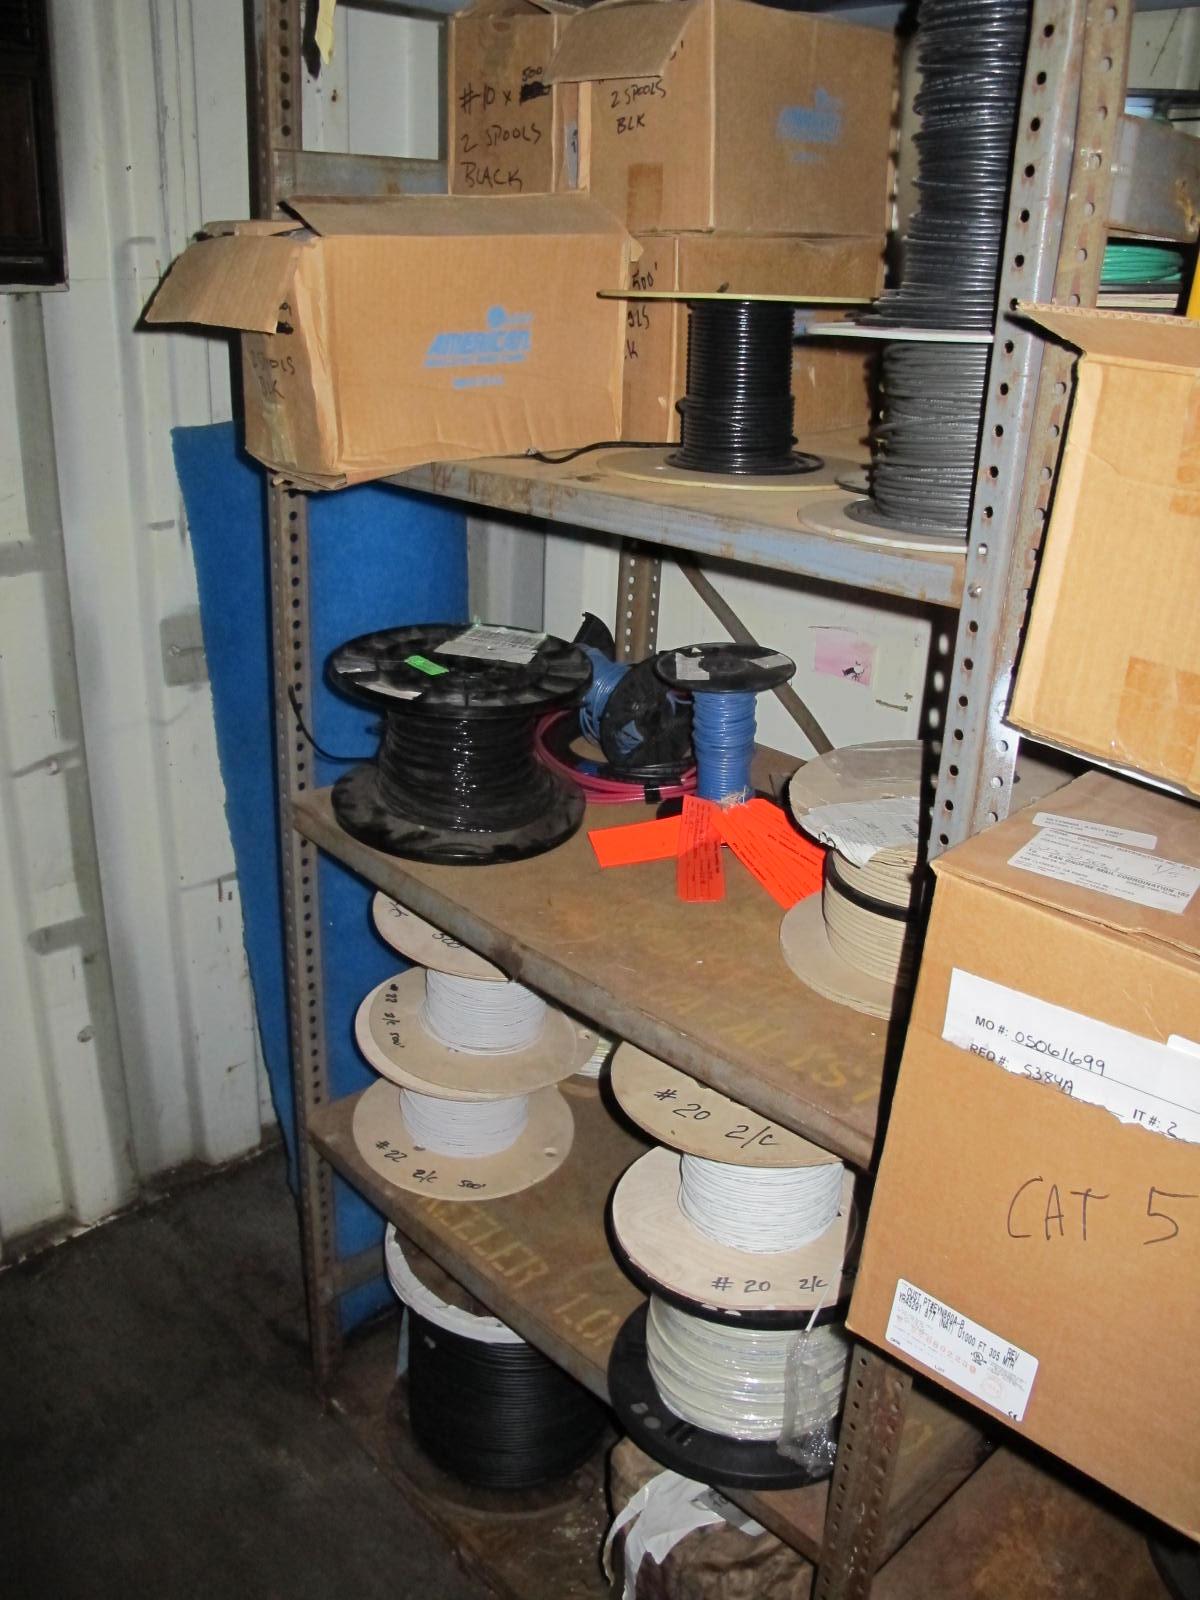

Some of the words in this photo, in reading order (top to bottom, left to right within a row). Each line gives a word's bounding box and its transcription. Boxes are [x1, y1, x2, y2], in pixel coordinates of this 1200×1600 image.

[610, 89, 620, 108] 2
[624, 79, 667, 105] SPOOLS
[460, 134, 479, 153] 2
[486, 122, 542, 147] SPOOLS
[616, 112, 646, 135] BLK
[460, 161, 523, 192] BLACK
[975, 1015, 995, 1031] MO
[1132, 1108, 1147, 1122] IT
[1007, 1175, 1110, 1242] CAT
[1143, 1186, 1199, 1245] 5
